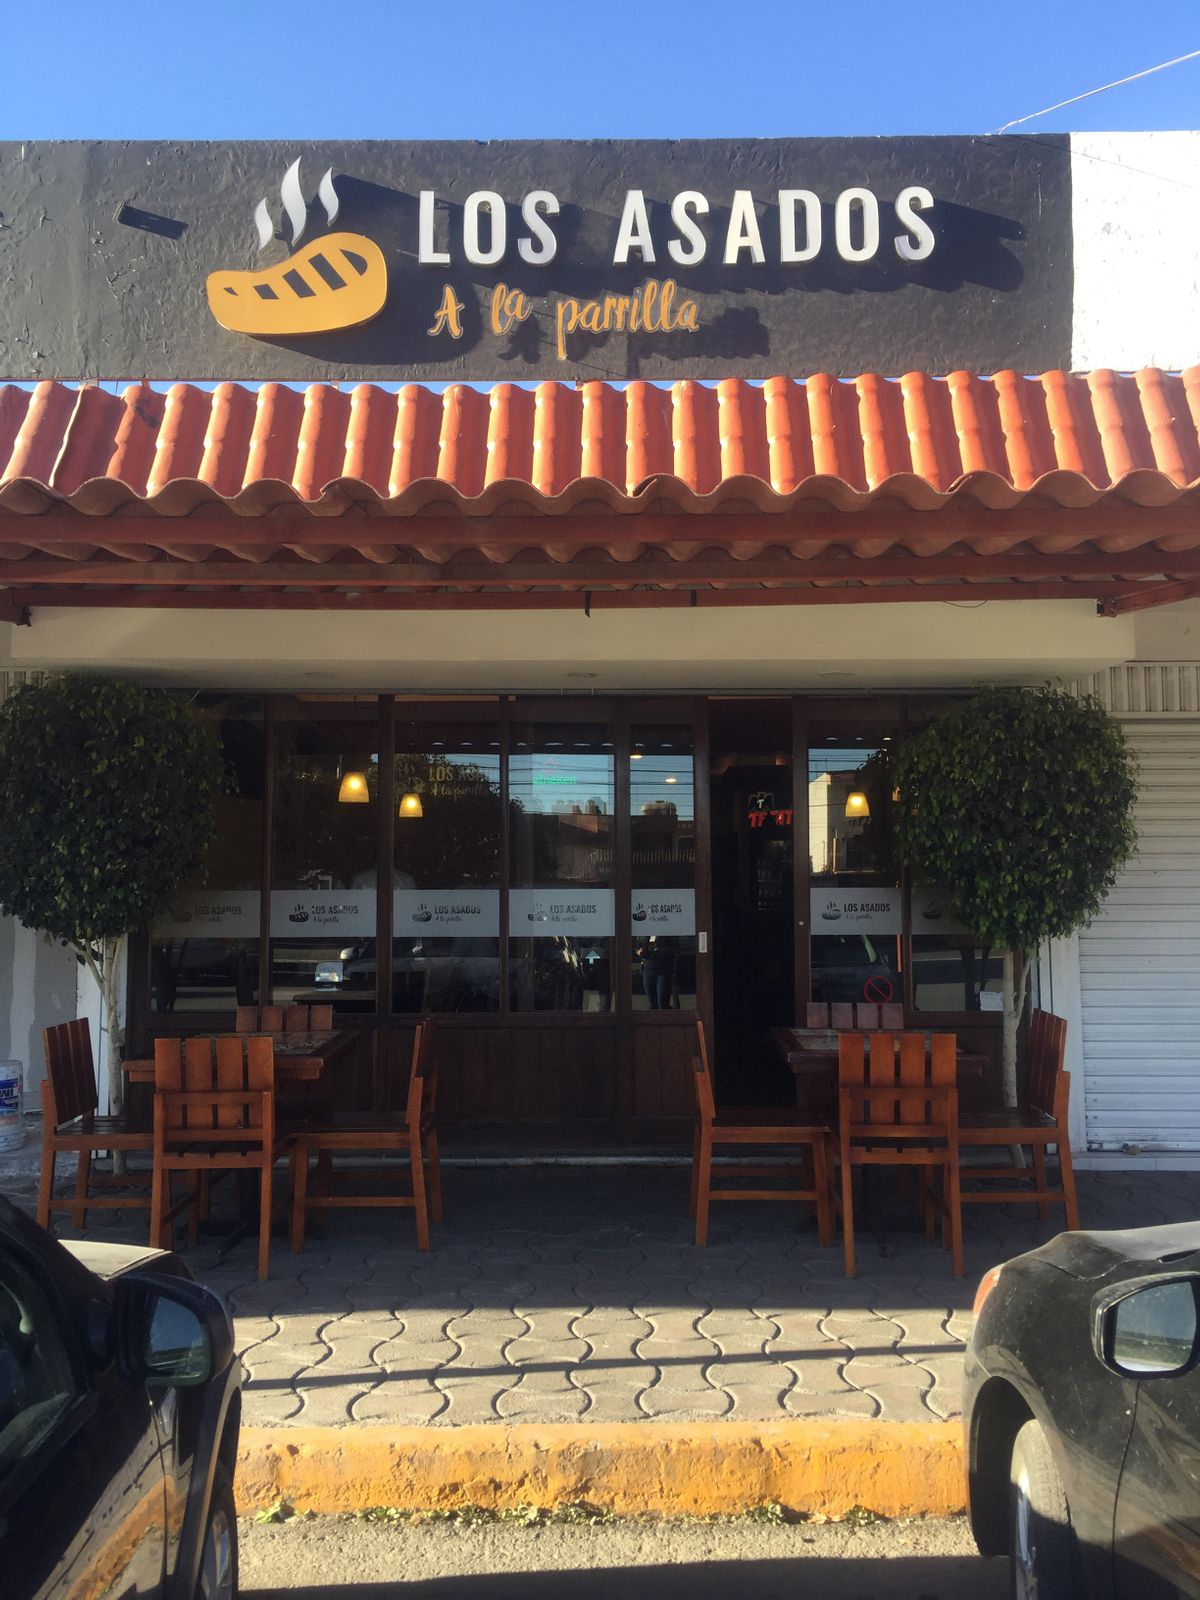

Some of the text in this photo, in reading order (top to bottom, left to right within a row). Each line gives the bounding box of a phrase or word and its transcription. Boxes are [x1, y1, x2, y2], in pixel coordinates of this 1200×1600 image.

[418, 187, 935, 265] LOS ASADOS
[427, 278, 699, 361] A la parrilla
[429, 766, 453, 781] LOS
[311, 904, 326, 915] LOS
[434, 904, 481, 914] LOS ASADOS
[550, 904, 597, 914] LOS ASADOS
[844, 903, 891, 913] LOS ASADOS
